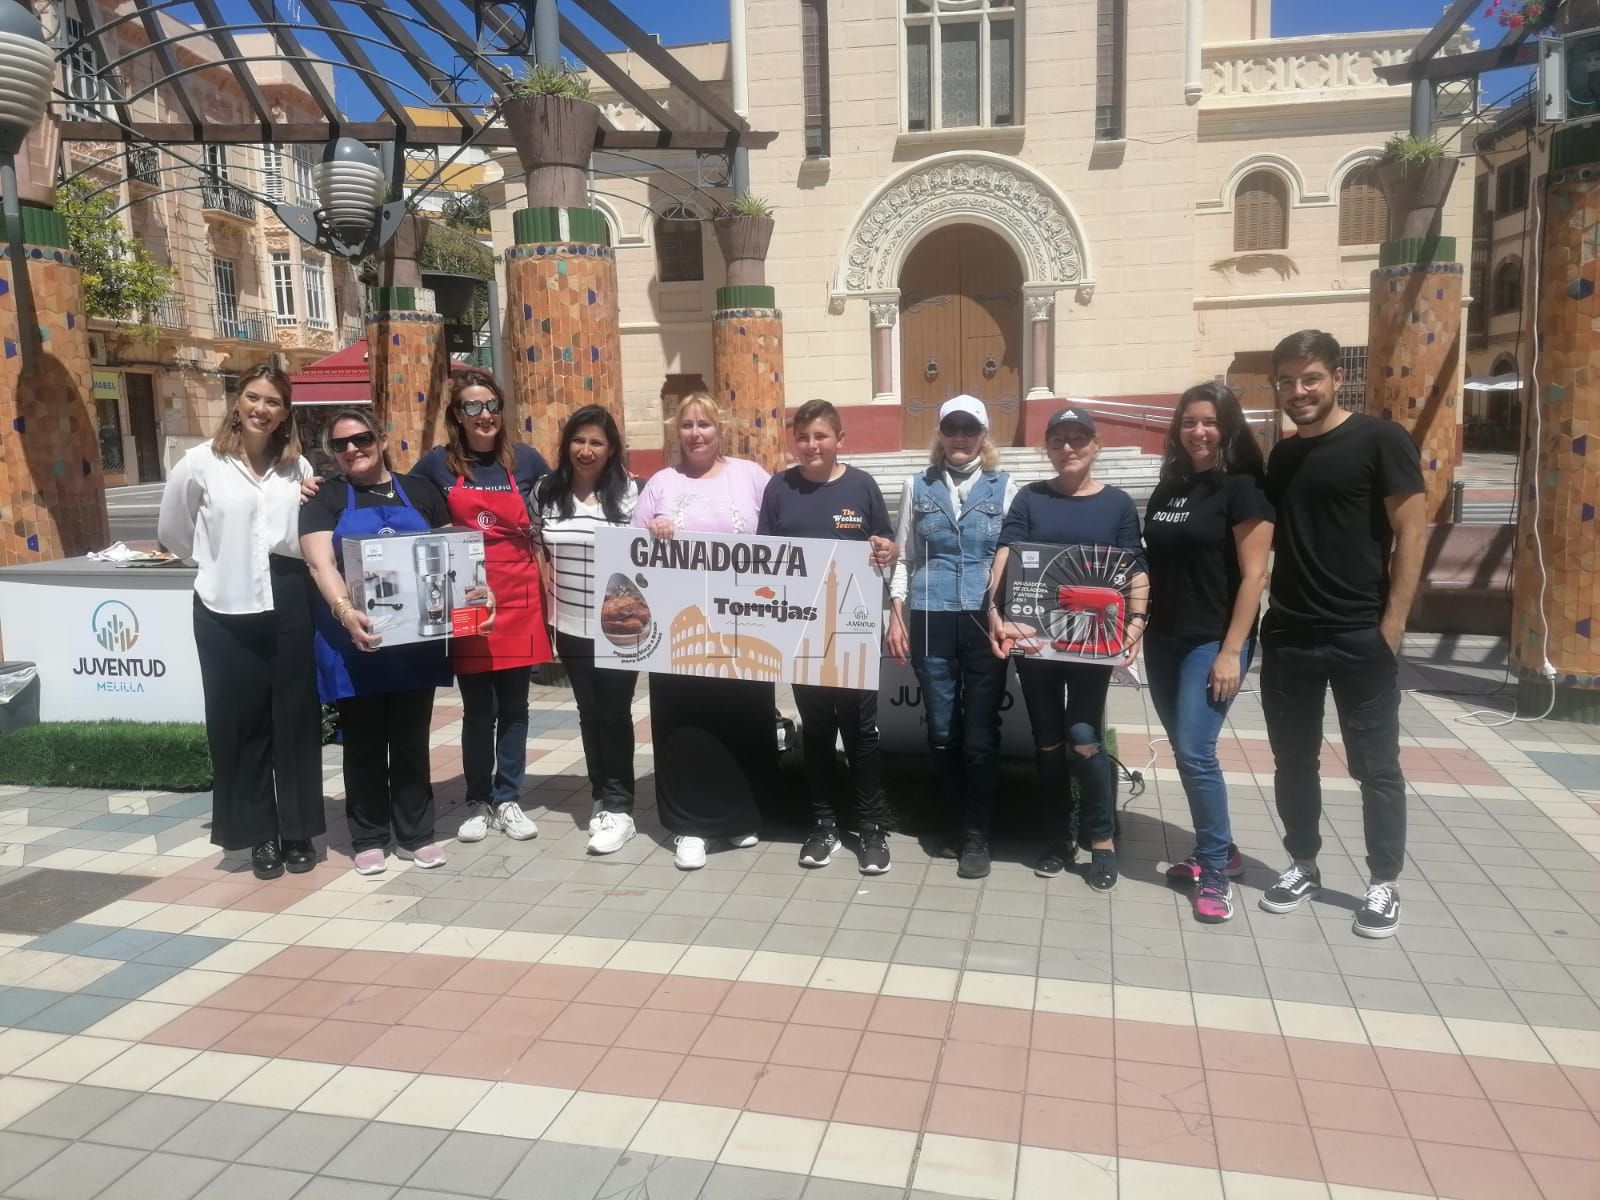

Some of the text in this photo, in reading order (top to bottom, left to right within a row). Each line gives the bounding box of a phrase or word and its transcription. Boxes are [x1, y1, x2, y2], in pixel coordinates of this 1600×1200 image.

[1167, 497, 1188, 508] ANY
[842, 508, 855, 516] The
[1152, 511, 1190, 523] DOUBT?
[630, 536, 808, 578] GANADOR/A
[713, 597, 818, 623] Torrijas
[846, 620, 876, 628] JUVENTUD
[72, 657, 166, 678] JUVENTUD
